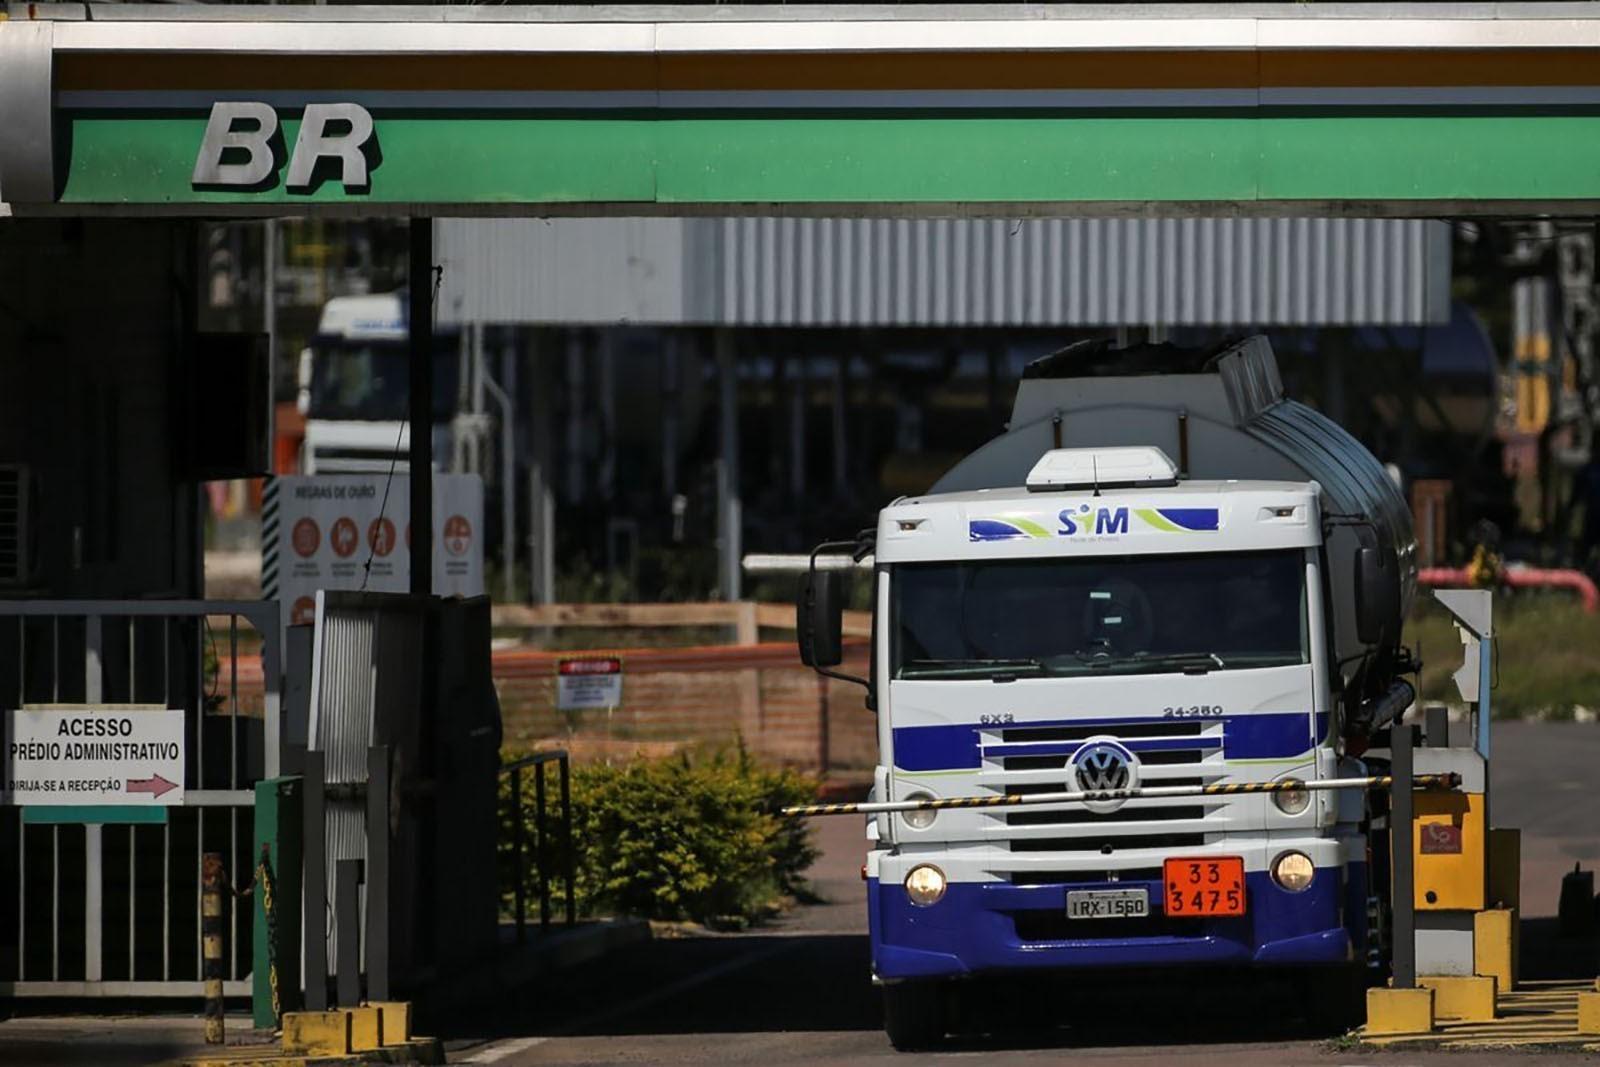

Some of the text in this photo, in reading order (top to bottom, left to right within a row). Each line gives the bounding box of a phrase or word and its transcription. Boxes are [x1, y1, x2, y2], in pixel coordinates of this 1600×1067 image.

[191, 101, 373, 187] BR
[58, 718, 132, 736] ACESSO
[10, 737, 179, 761] PRÉDIO ADMINISTRATIVO
[9, 776, 121, 794] DIRIJA-SE A RECEPÇÃO
[1171, 890, 1239, 911] 3475
